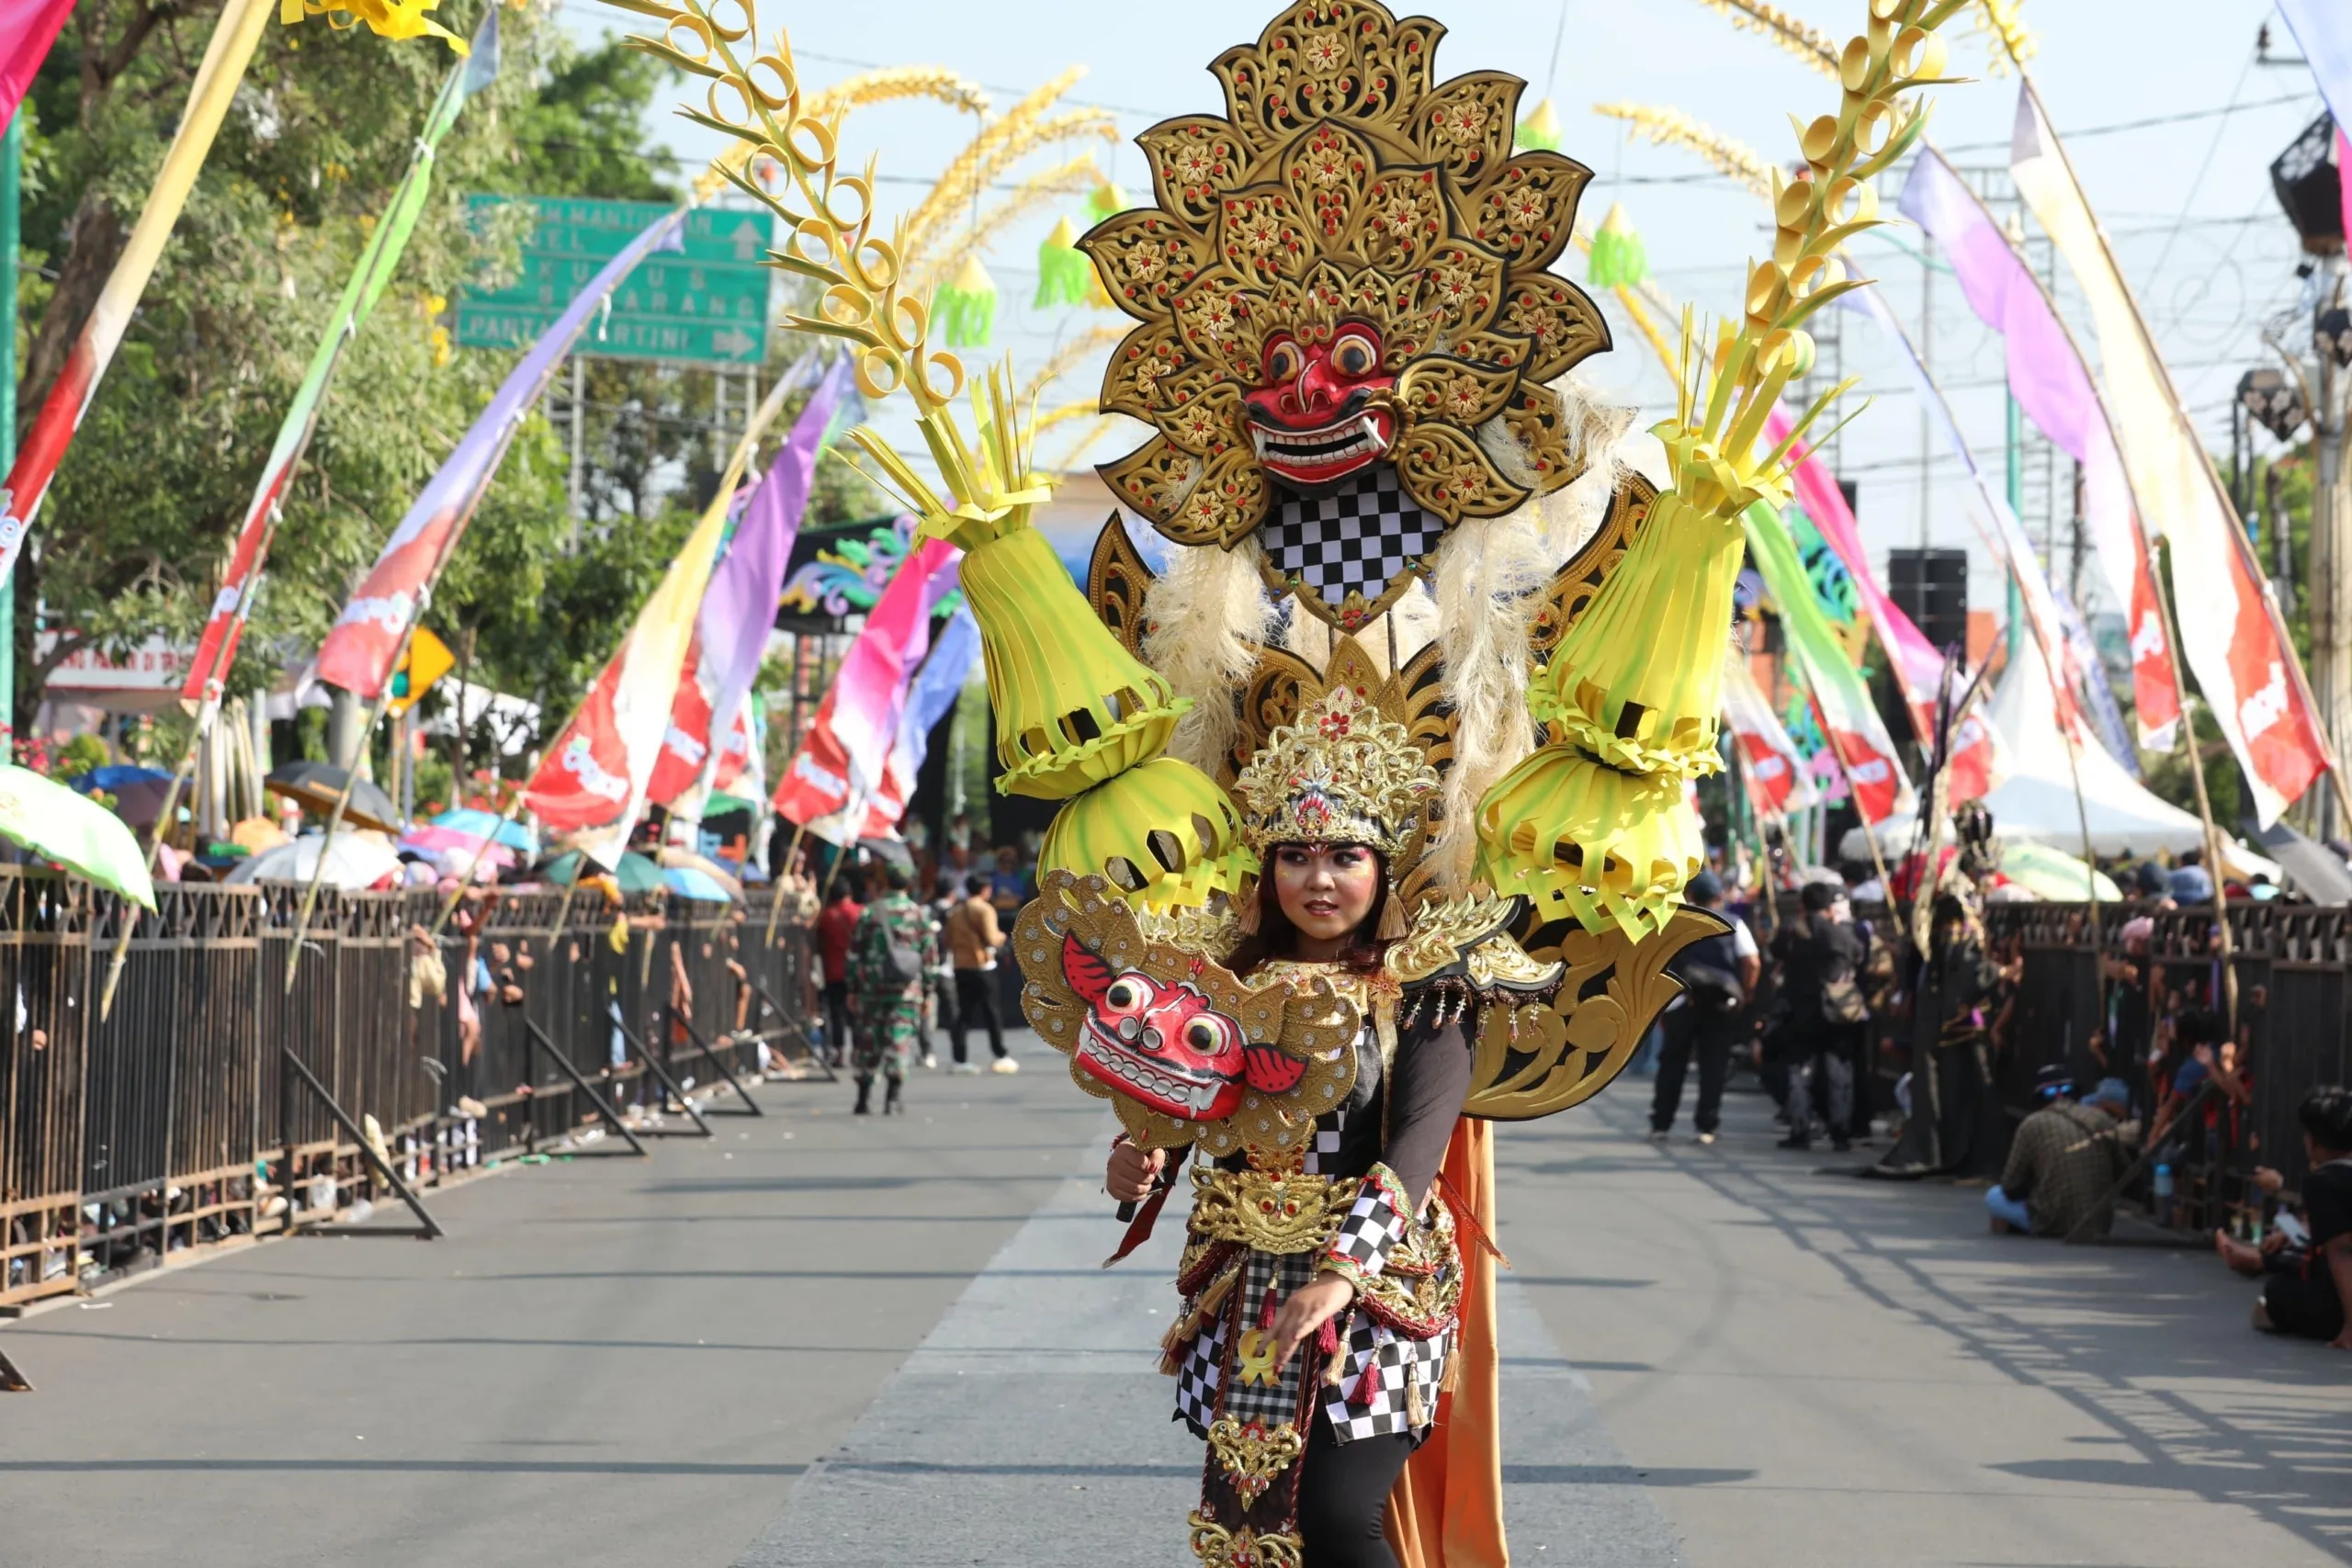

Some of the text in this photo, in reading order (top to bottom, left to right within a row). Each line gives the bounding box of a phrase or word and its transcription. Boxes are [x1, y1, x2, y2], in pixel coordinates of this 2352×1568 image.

[539, 261, 707, 291] KUUS
[539, 284, 755, 316] SEARANG
[469, 315, 549, 341] PANTA
